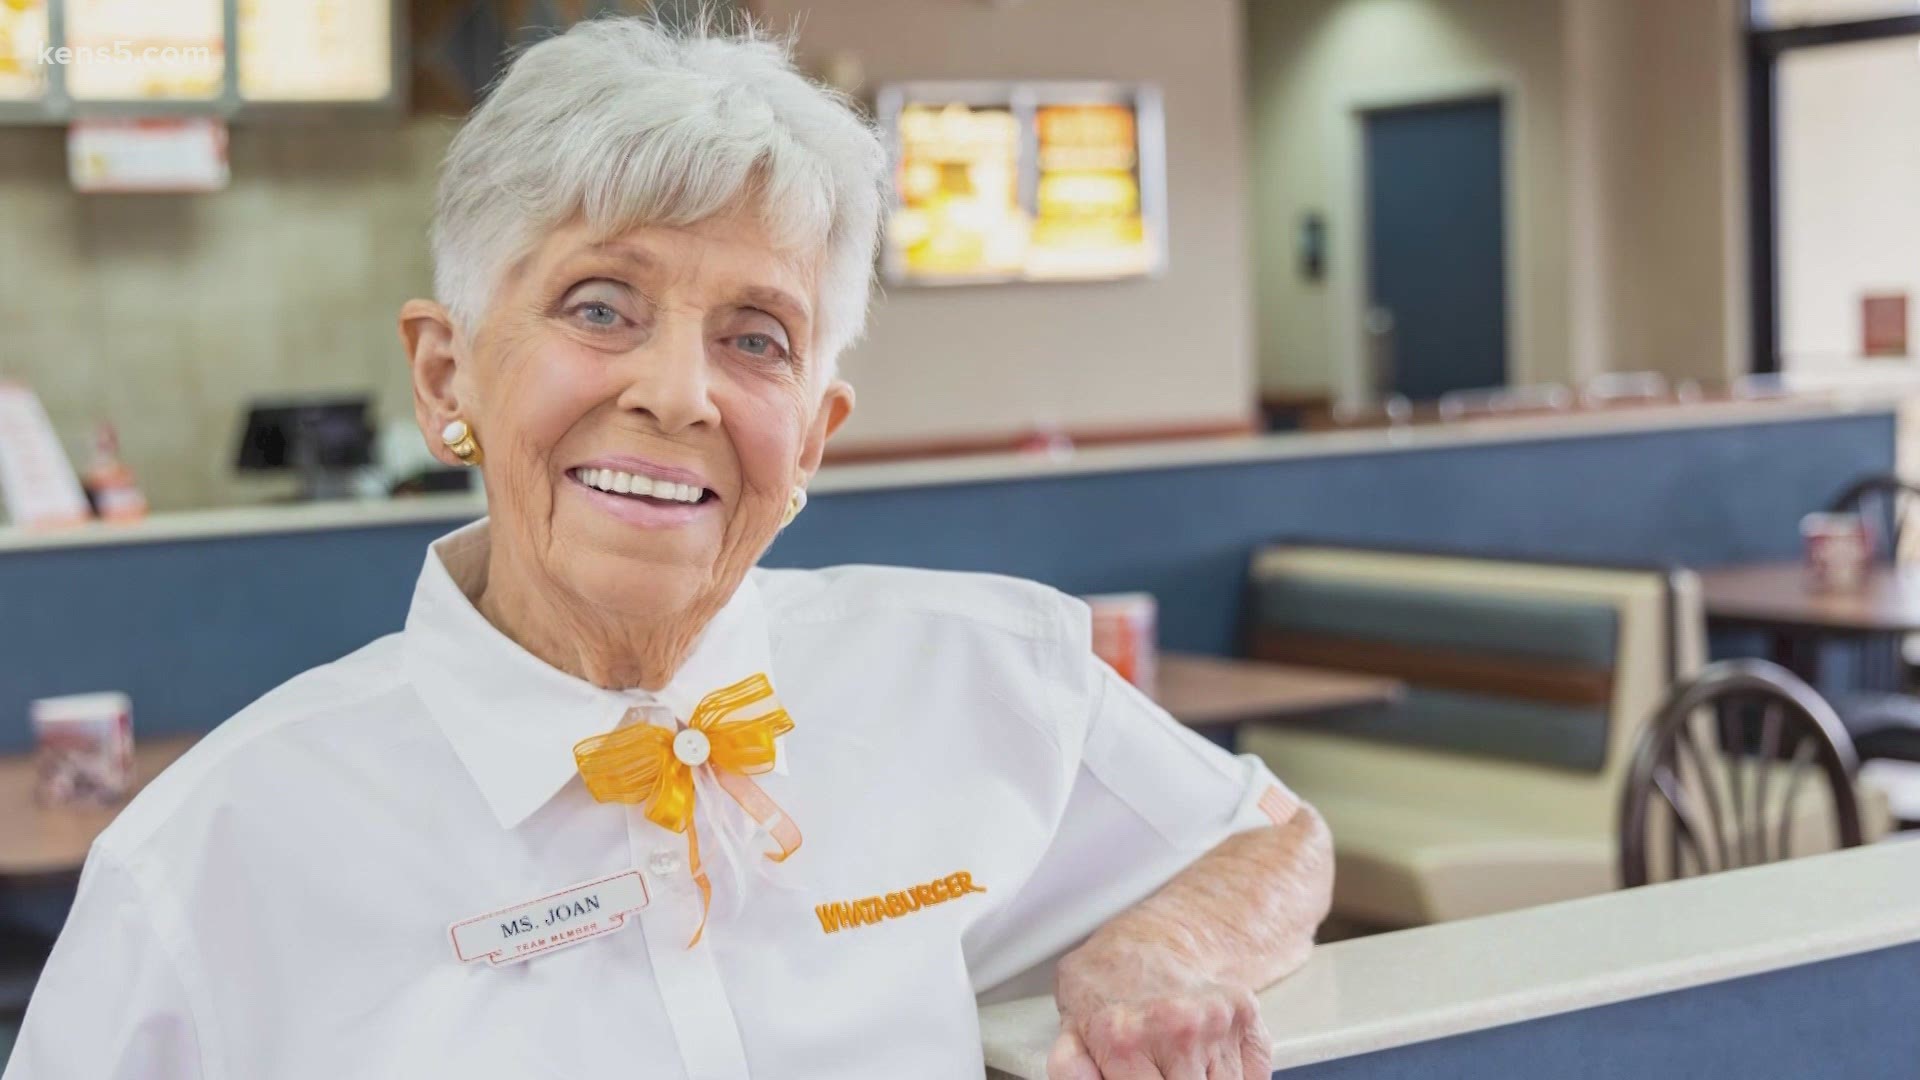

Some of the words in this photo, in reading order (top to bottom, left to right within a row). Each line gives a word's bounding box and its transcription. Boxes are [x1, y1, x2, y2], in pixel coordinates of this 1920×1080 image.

[500, 915, 539, 938] MS.
[545, 895, 601, 927] JOAN
[815, 871, 987, 934] WHATABURGER
[515, 938, 546, 952] TEAM
[551, 922, 598, 942] MEMBER
